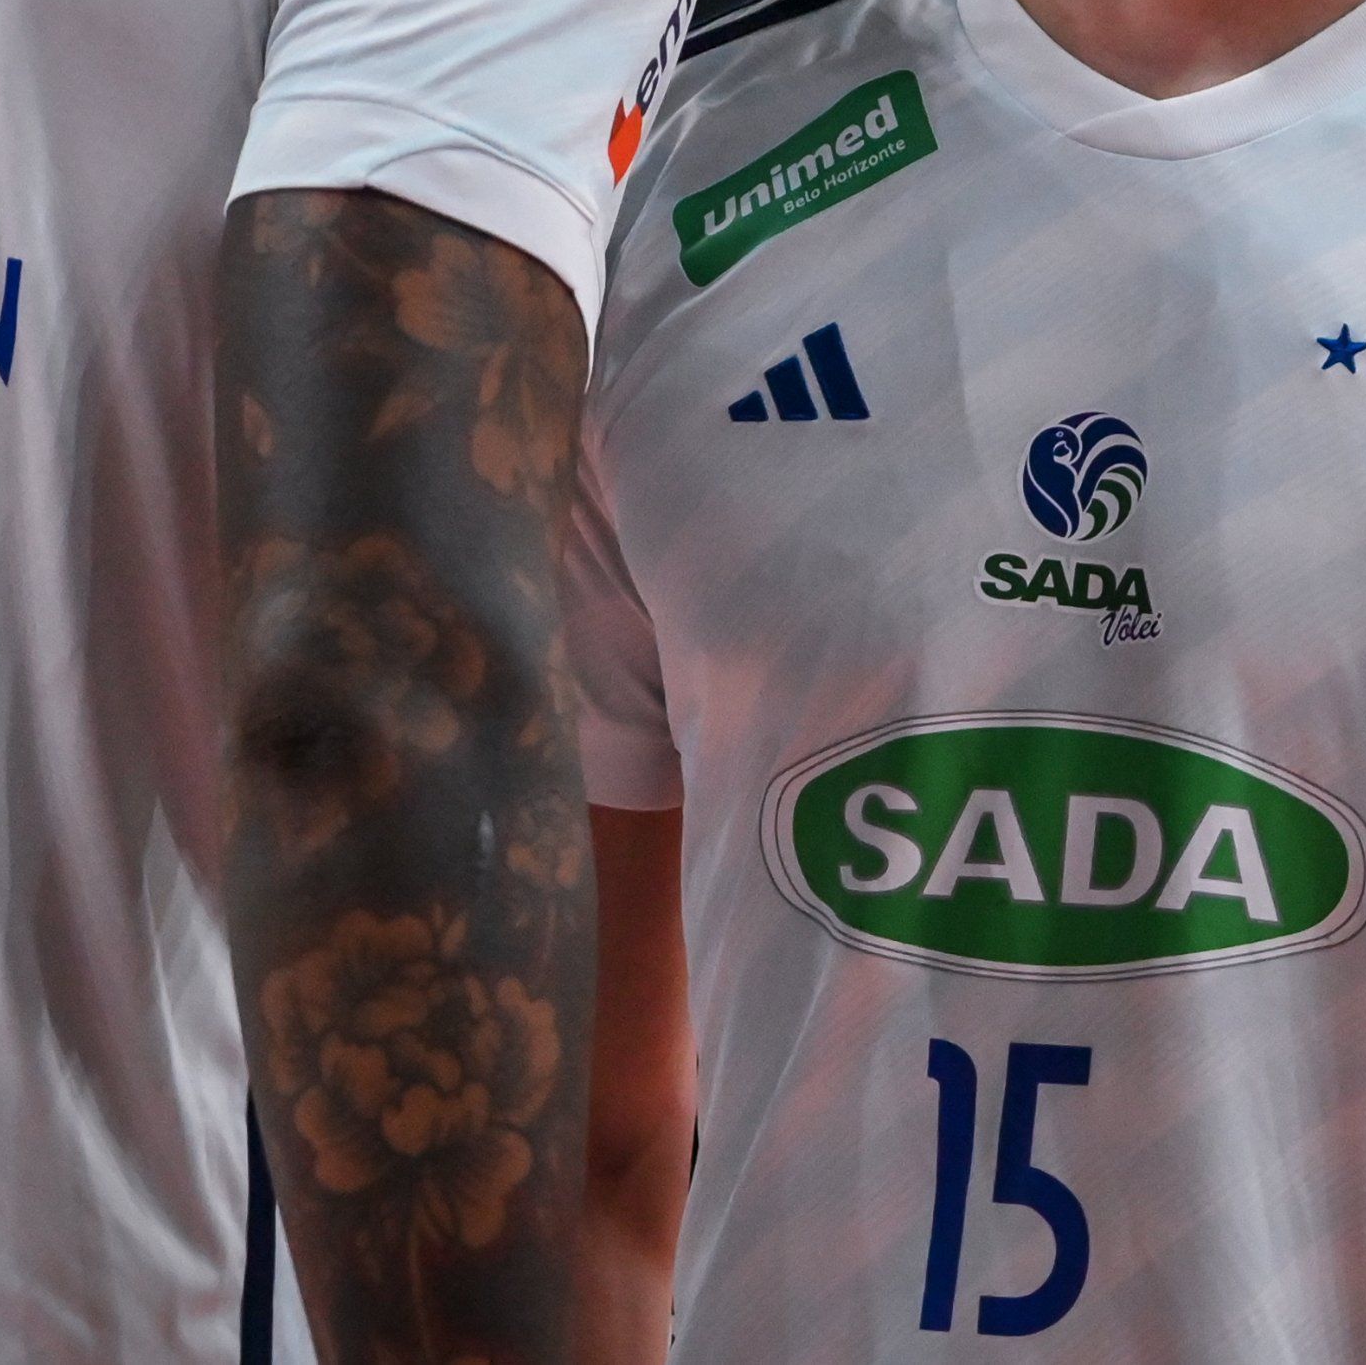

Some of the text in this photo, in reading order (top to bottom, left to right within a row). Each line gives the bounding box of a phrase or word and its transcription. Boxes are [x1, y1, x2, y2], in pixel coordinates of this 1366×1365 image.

[783, 137, 906, 215] Belo Horizonte
[980, 553, 1153, 615] SADA
[839, 784, 1281, 923] SADA
[919, 1037, 1093, 1337] 15
